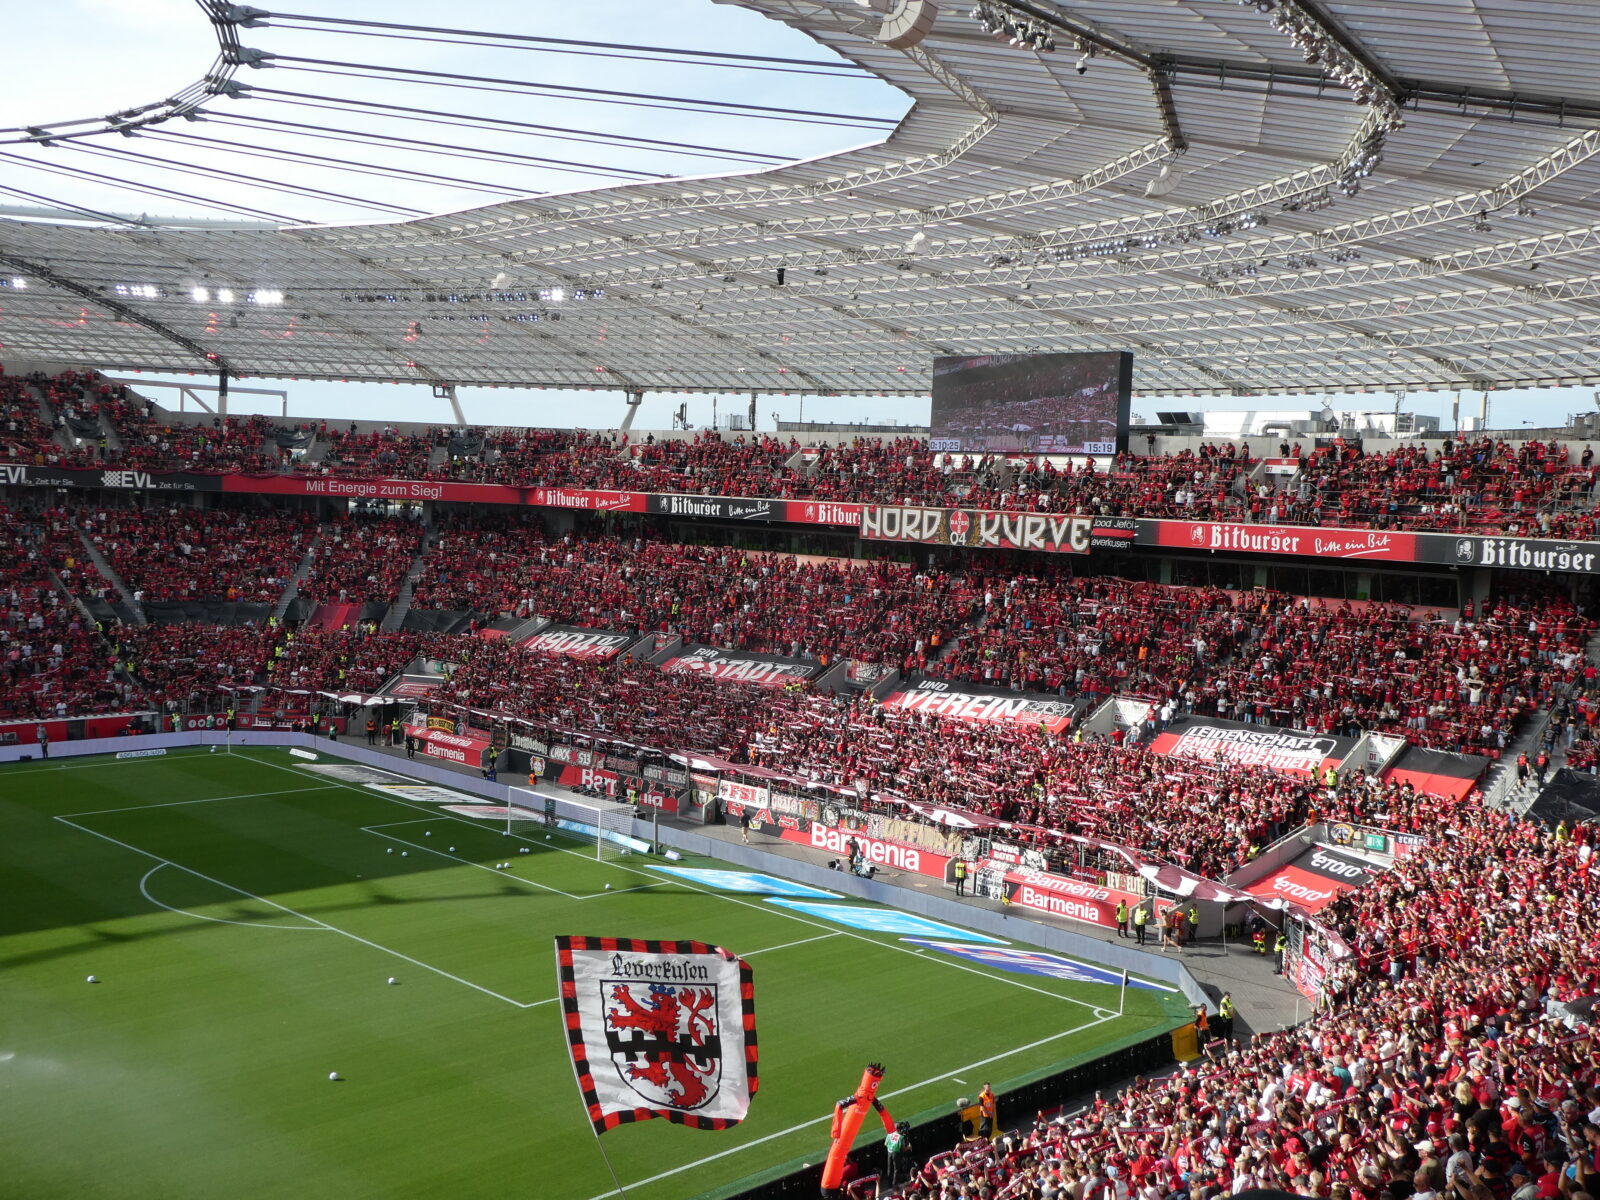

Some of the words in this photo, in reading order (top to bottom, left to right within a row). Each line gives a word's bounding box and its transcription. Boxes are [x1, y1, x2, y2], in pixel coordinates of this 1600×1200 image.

[1088, 444, 1113, 453] 15:19
[121, 471, 157, 488] EVL
[306, 480, 325, 492] Mit
[328, 481, 377, 496] Energie
[380, 486, 407, 495] zum
[411, 486, 443, 499] Sieg!
[546, 490, 589, 508] Bitburger
[670, 496, 721, 516] Bitburger
[728, 504, 744, 516] Bitte
[757, 500, 771, 511] Bit
[862, 505, 942, 541] NORD
[980, 512, 1092, 551] KURVE
[950, 531, 966, 545] 04
[1091, 537, 1131, 549] everkusen
[1209, 525, 1300, 552] Bitburger
[1315, 537, 1342, 554] Bitte
[1345, 539, 1366, 550] ein
[1367, 533, 1391, 548] Bit
[1479, 539, 1596, 571] Bitburger
[708, 657, 791, 682] STADT
[917, 680, 949, 691] UND
[901, 689, 1029, 718] VEREIN
[428, 731, 473, 747] Barmenia
[1188, 726, 1322, 749] LEIDENSCHAFT
[427, 742, 465, 762] Barmenia
[1025, 870, 1111, 900] Barmenia
[1023, 887, 1099, 921] Barmenia
